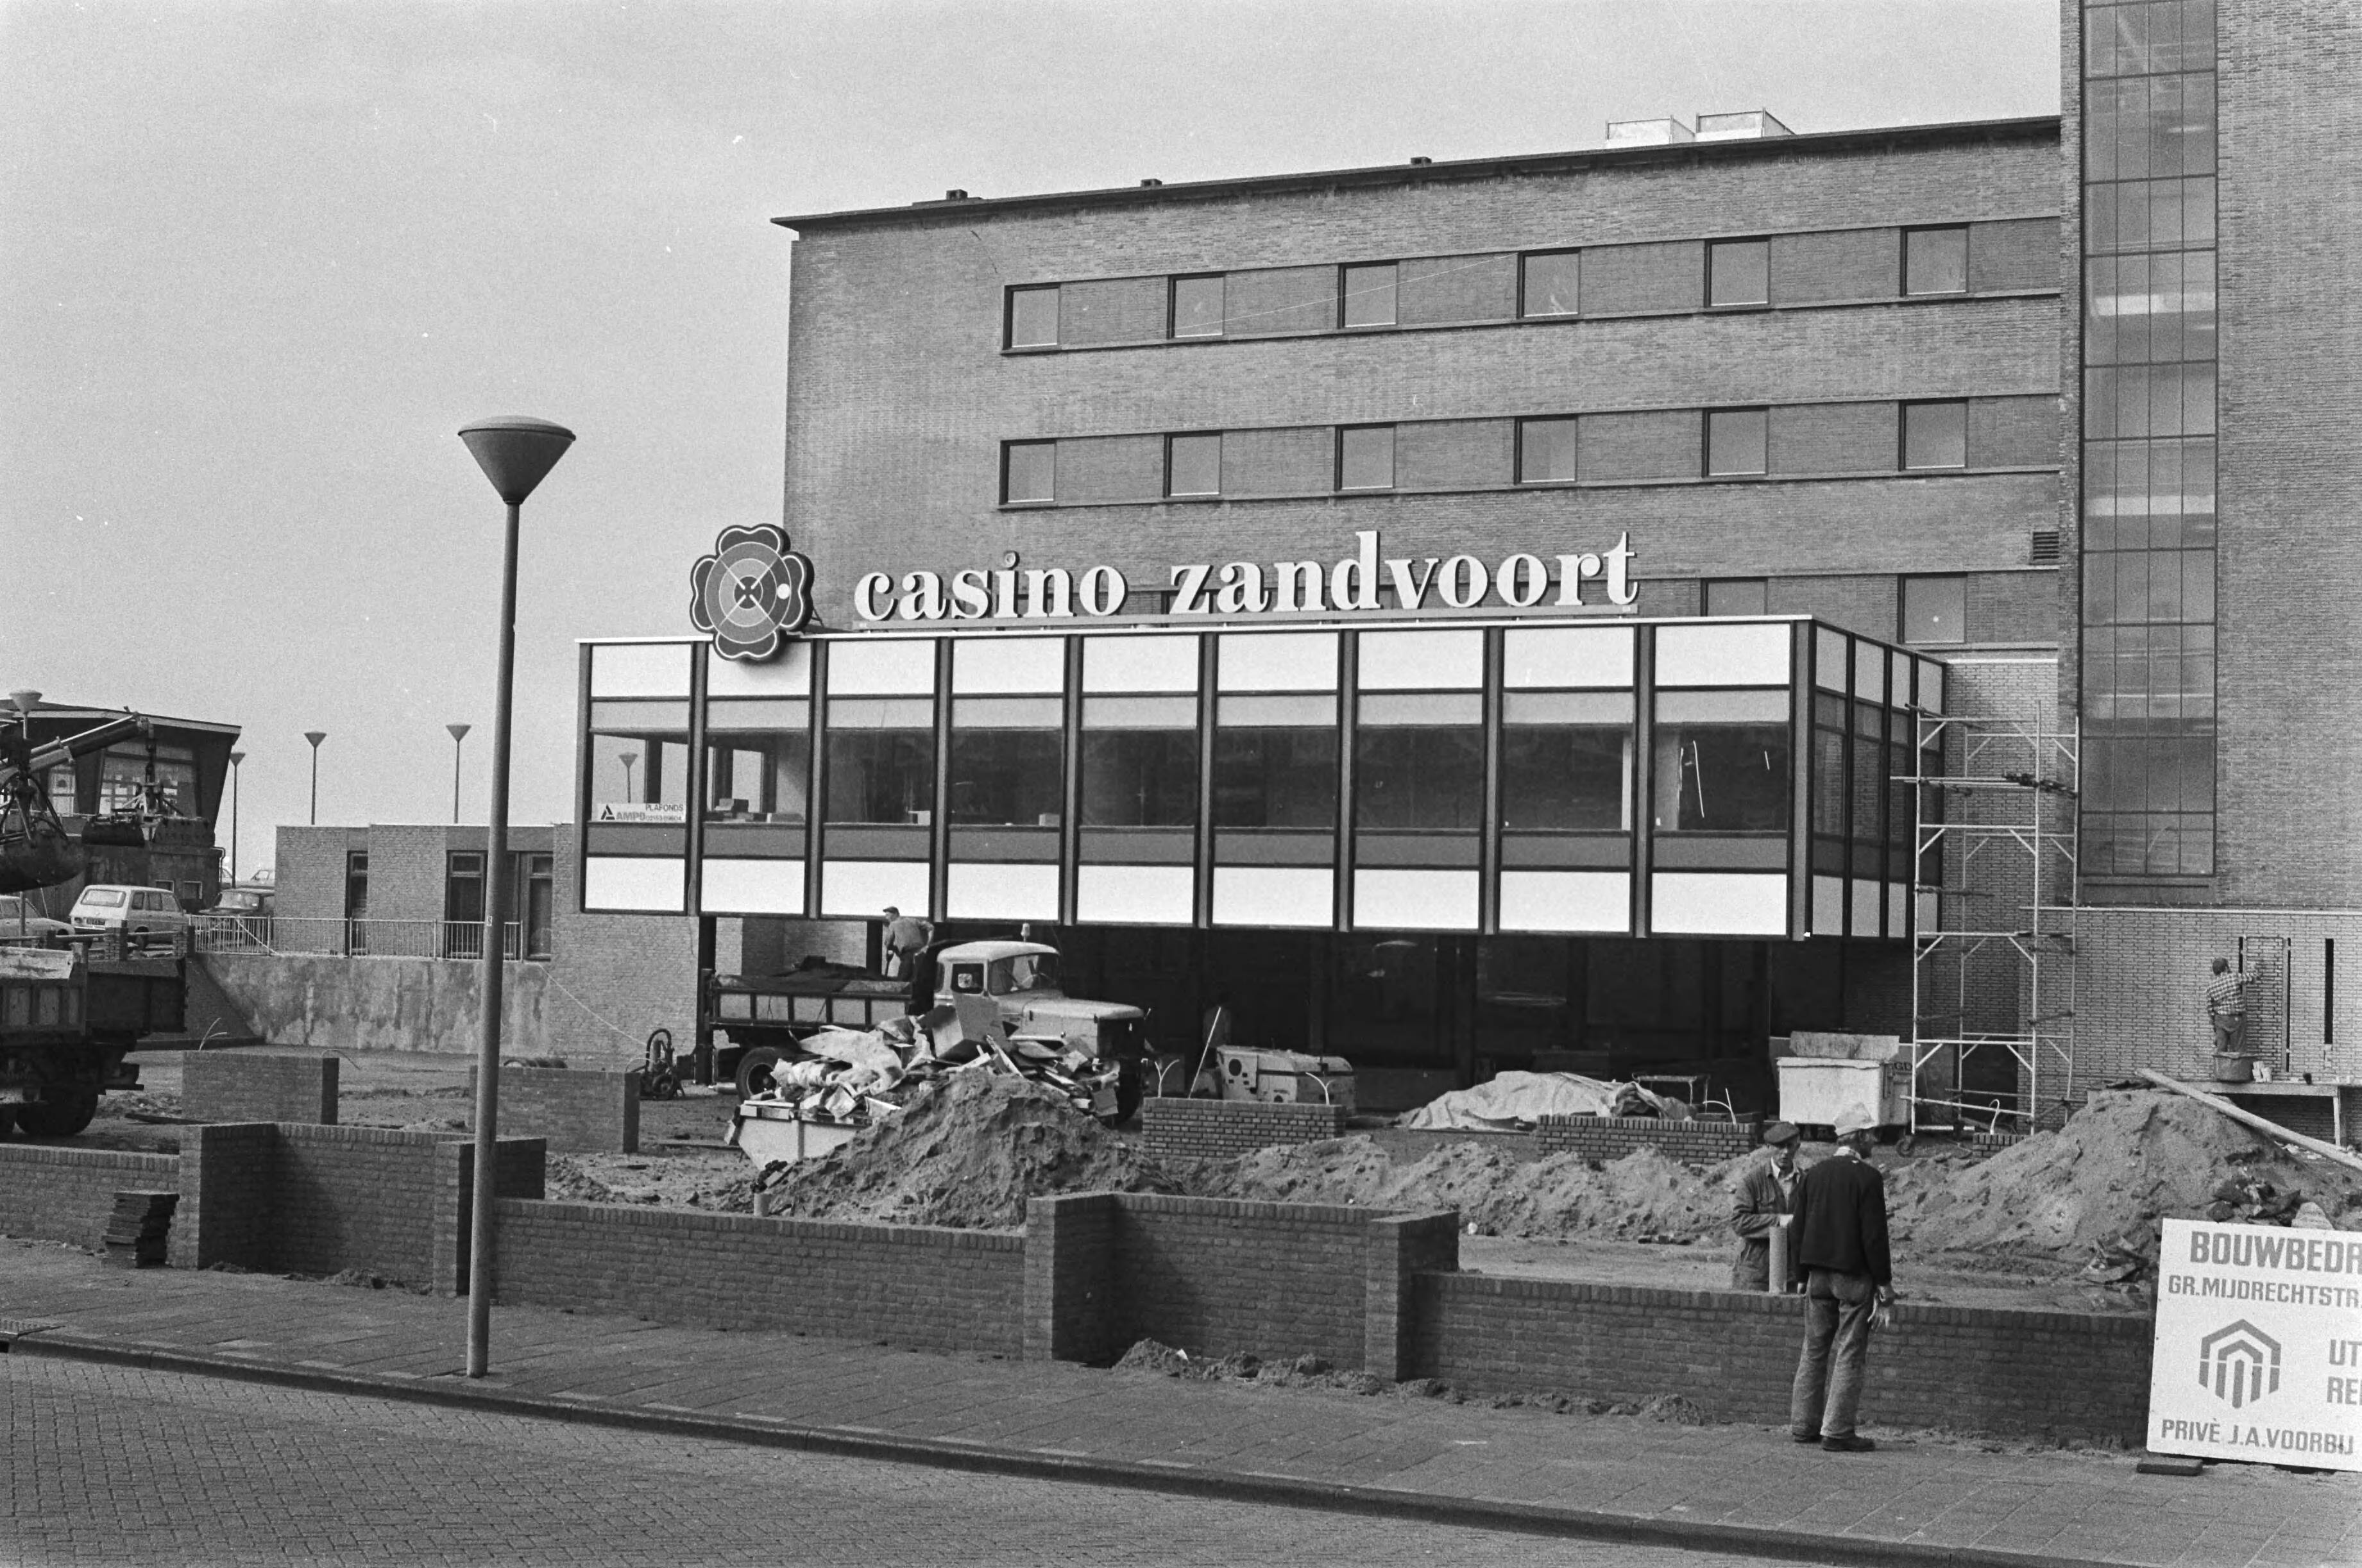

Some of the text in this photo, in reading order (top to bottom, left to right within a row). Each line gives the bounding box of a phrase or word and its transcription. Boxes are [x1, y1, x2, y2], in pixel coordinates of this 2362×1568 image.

[854, 530, 1638, 620] casino zandvoort
[646, 804, 684, 812] PLAFONDS
[2327, 1376, 2362, 1406] RE
